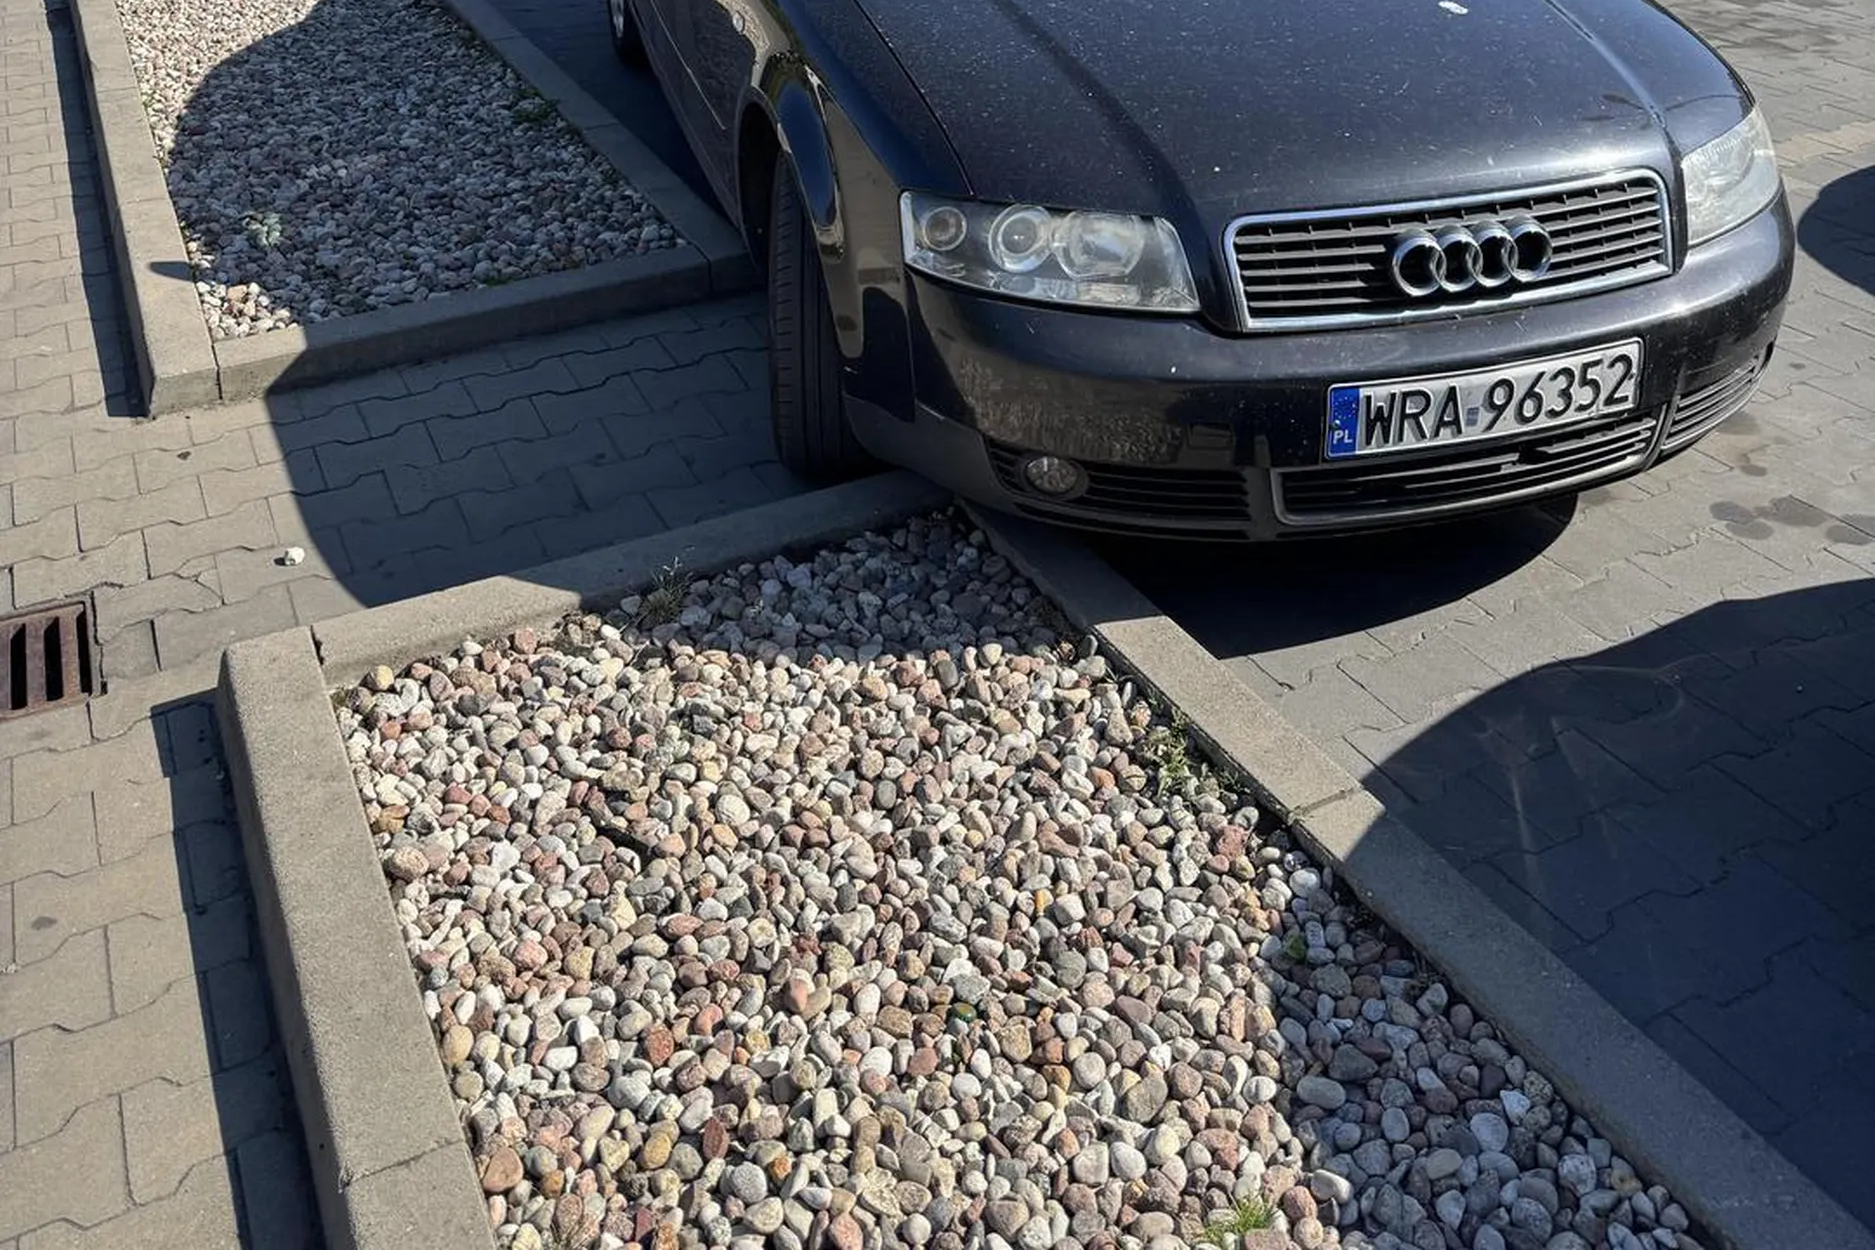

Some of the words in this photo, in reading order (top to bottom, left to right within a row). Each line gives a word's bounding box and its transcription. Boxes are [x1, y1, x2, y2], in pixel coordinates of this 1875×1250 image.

[1363, 383, 1464, 447] WRA
[1482, 354, 1633, 432] 96352
[1333, 430, 1354, 445] PL
